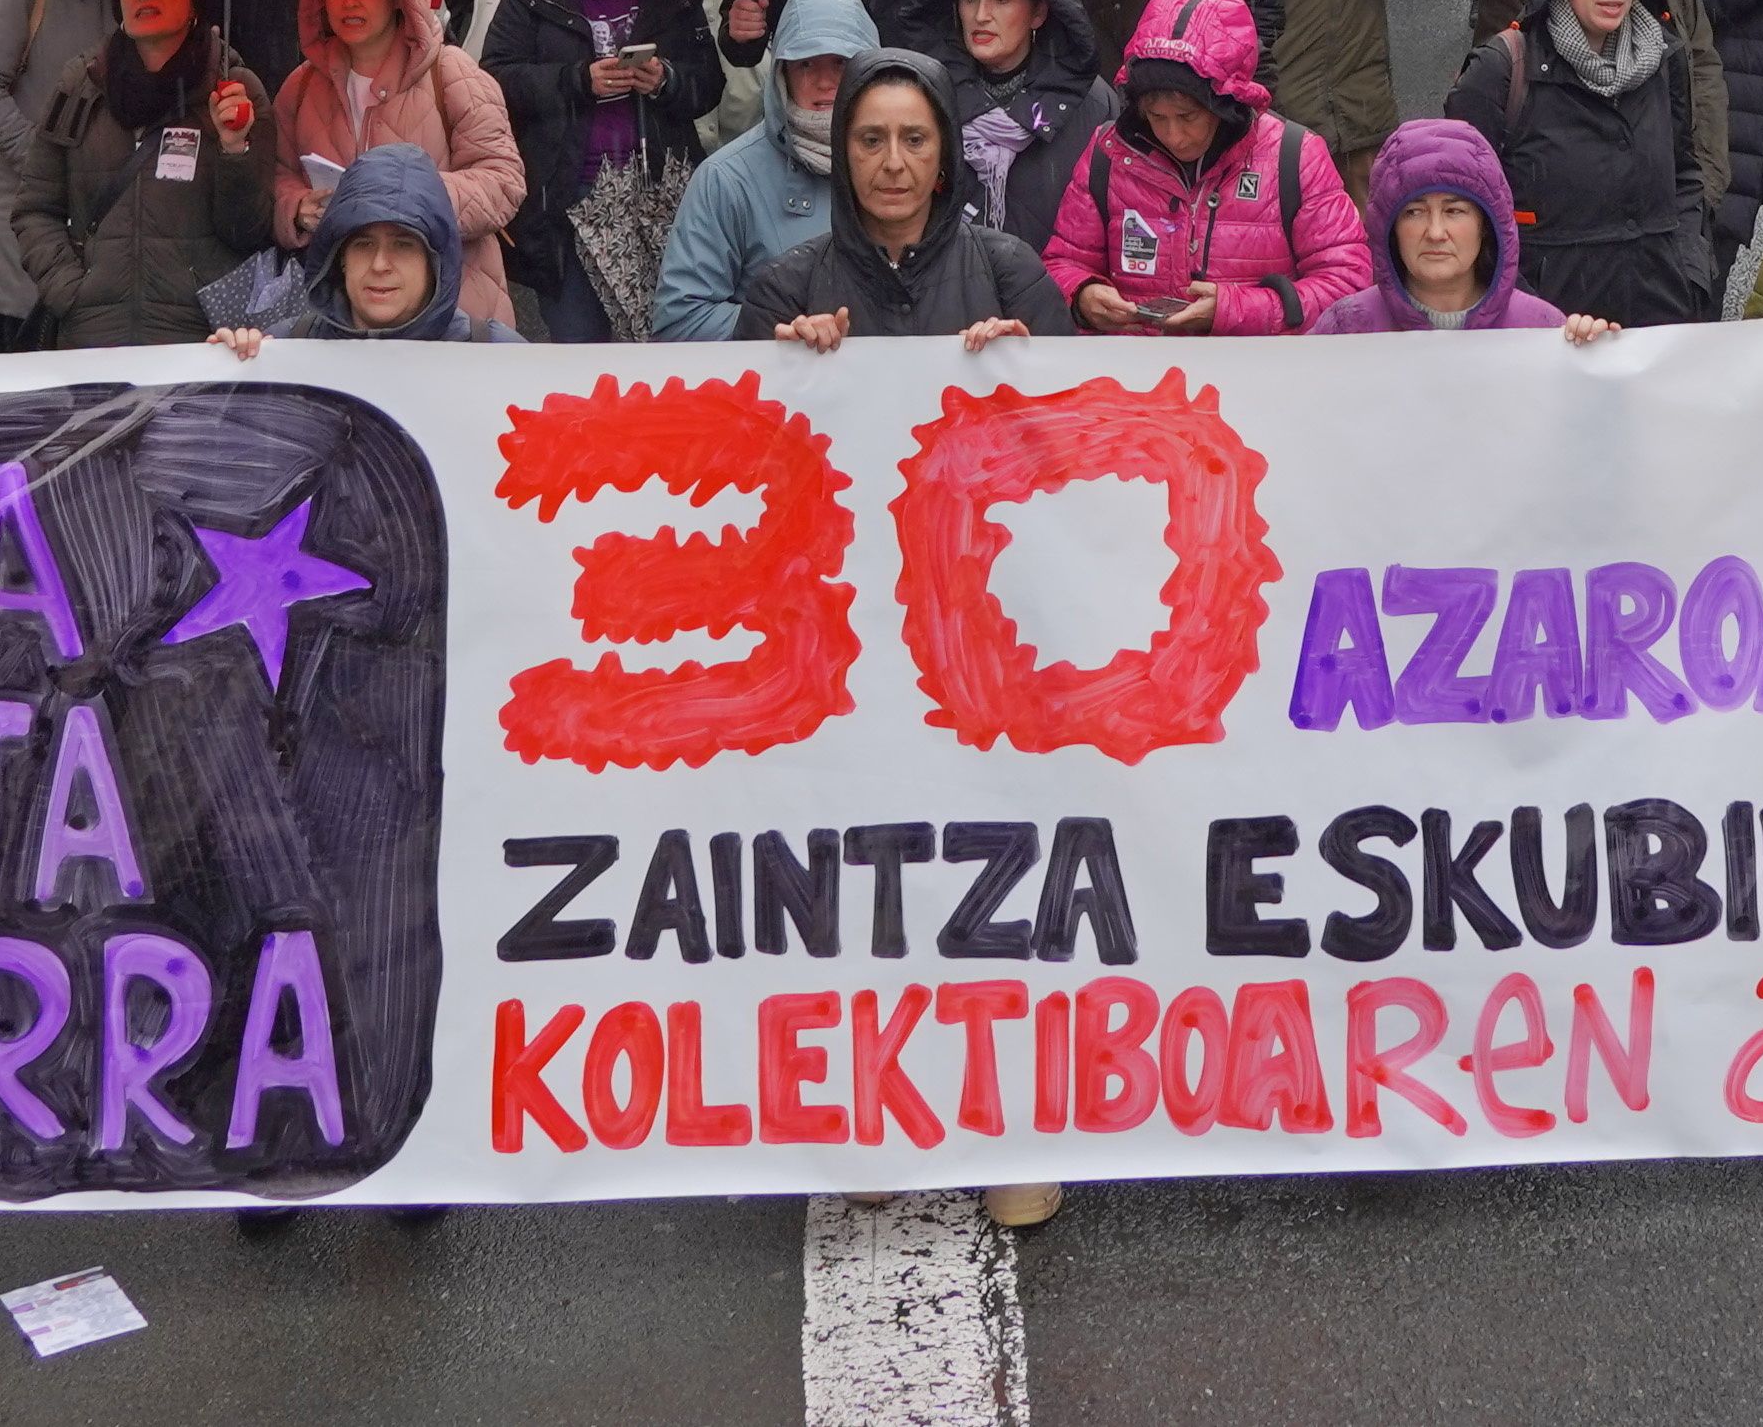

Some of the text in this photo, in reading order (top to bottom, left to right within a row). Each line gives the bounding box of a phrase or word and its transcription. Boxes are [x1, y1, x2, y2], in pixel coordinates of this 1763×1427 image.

[1127, 259, 1148, 272] 30
[494, 366, 1283, 774] 30
[496, 816, 1140, 965] ZAINTZA
